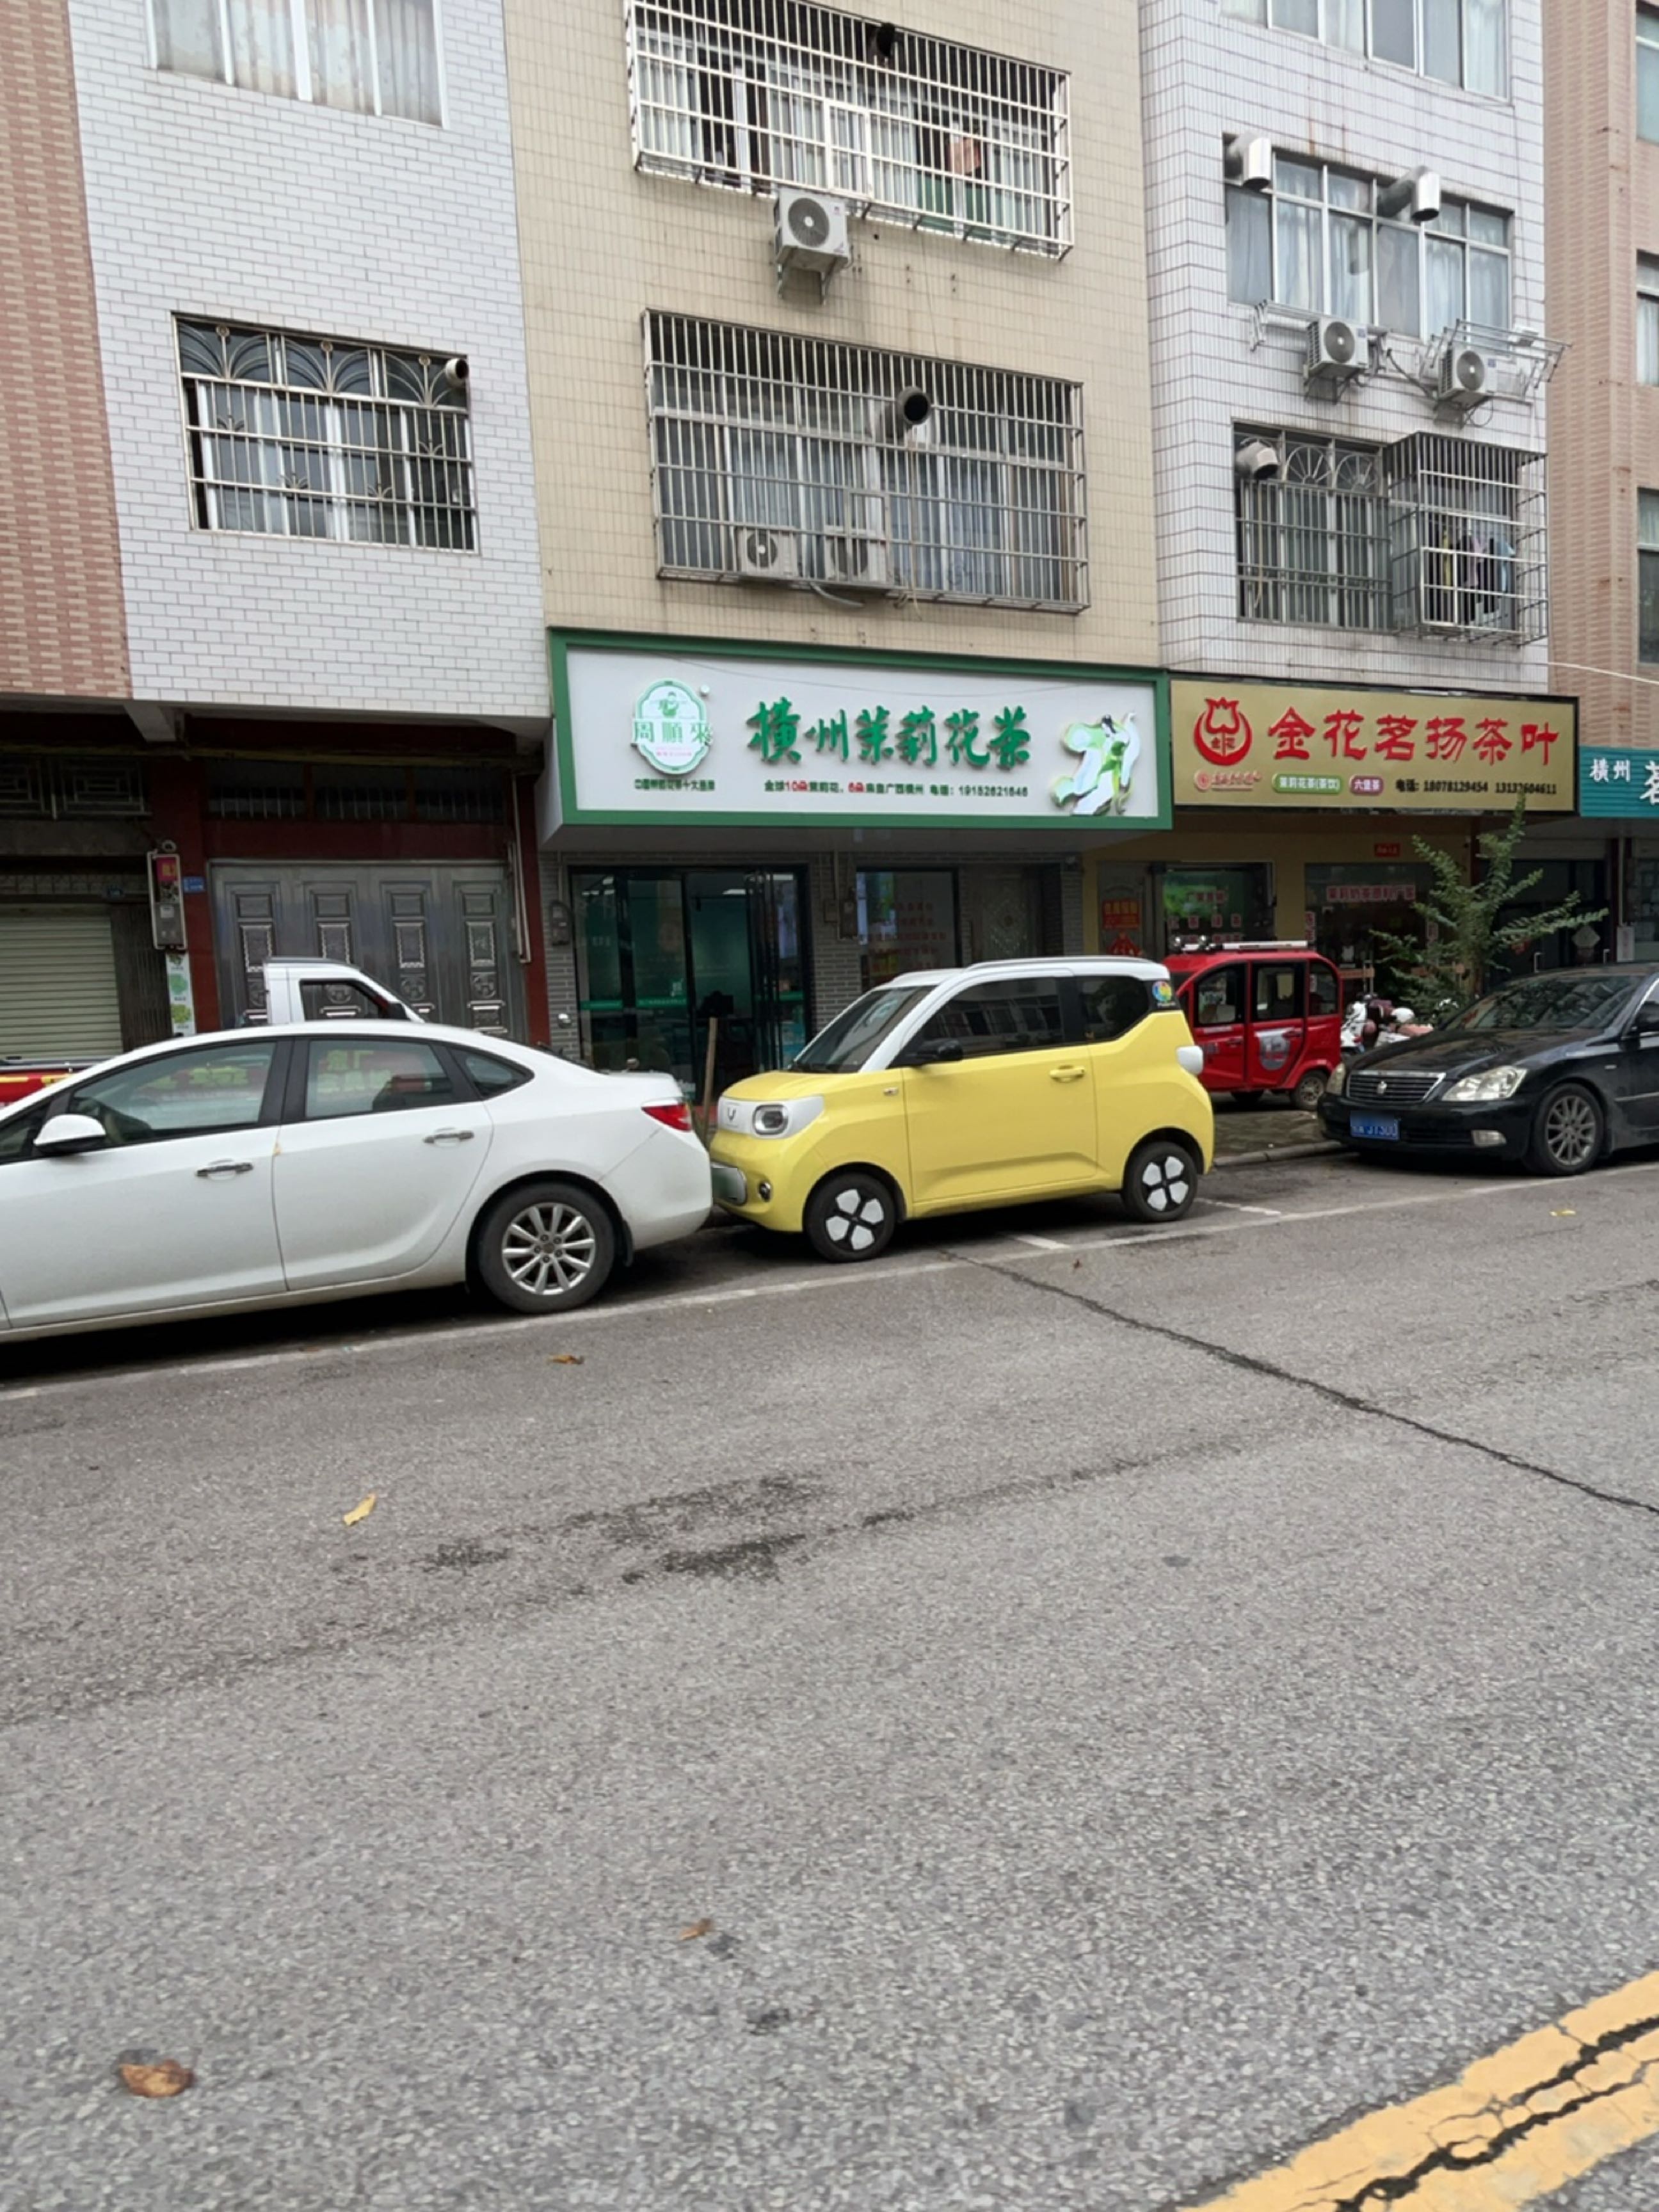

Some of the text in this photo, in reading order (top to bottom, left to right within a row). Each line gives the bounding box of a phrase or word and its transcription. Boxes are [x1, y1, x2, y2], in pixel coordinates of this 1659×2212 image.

[1268, 706, 1560, 766] 金花茗扬茶叶
[1589, 758, 1631, 783] 横州
